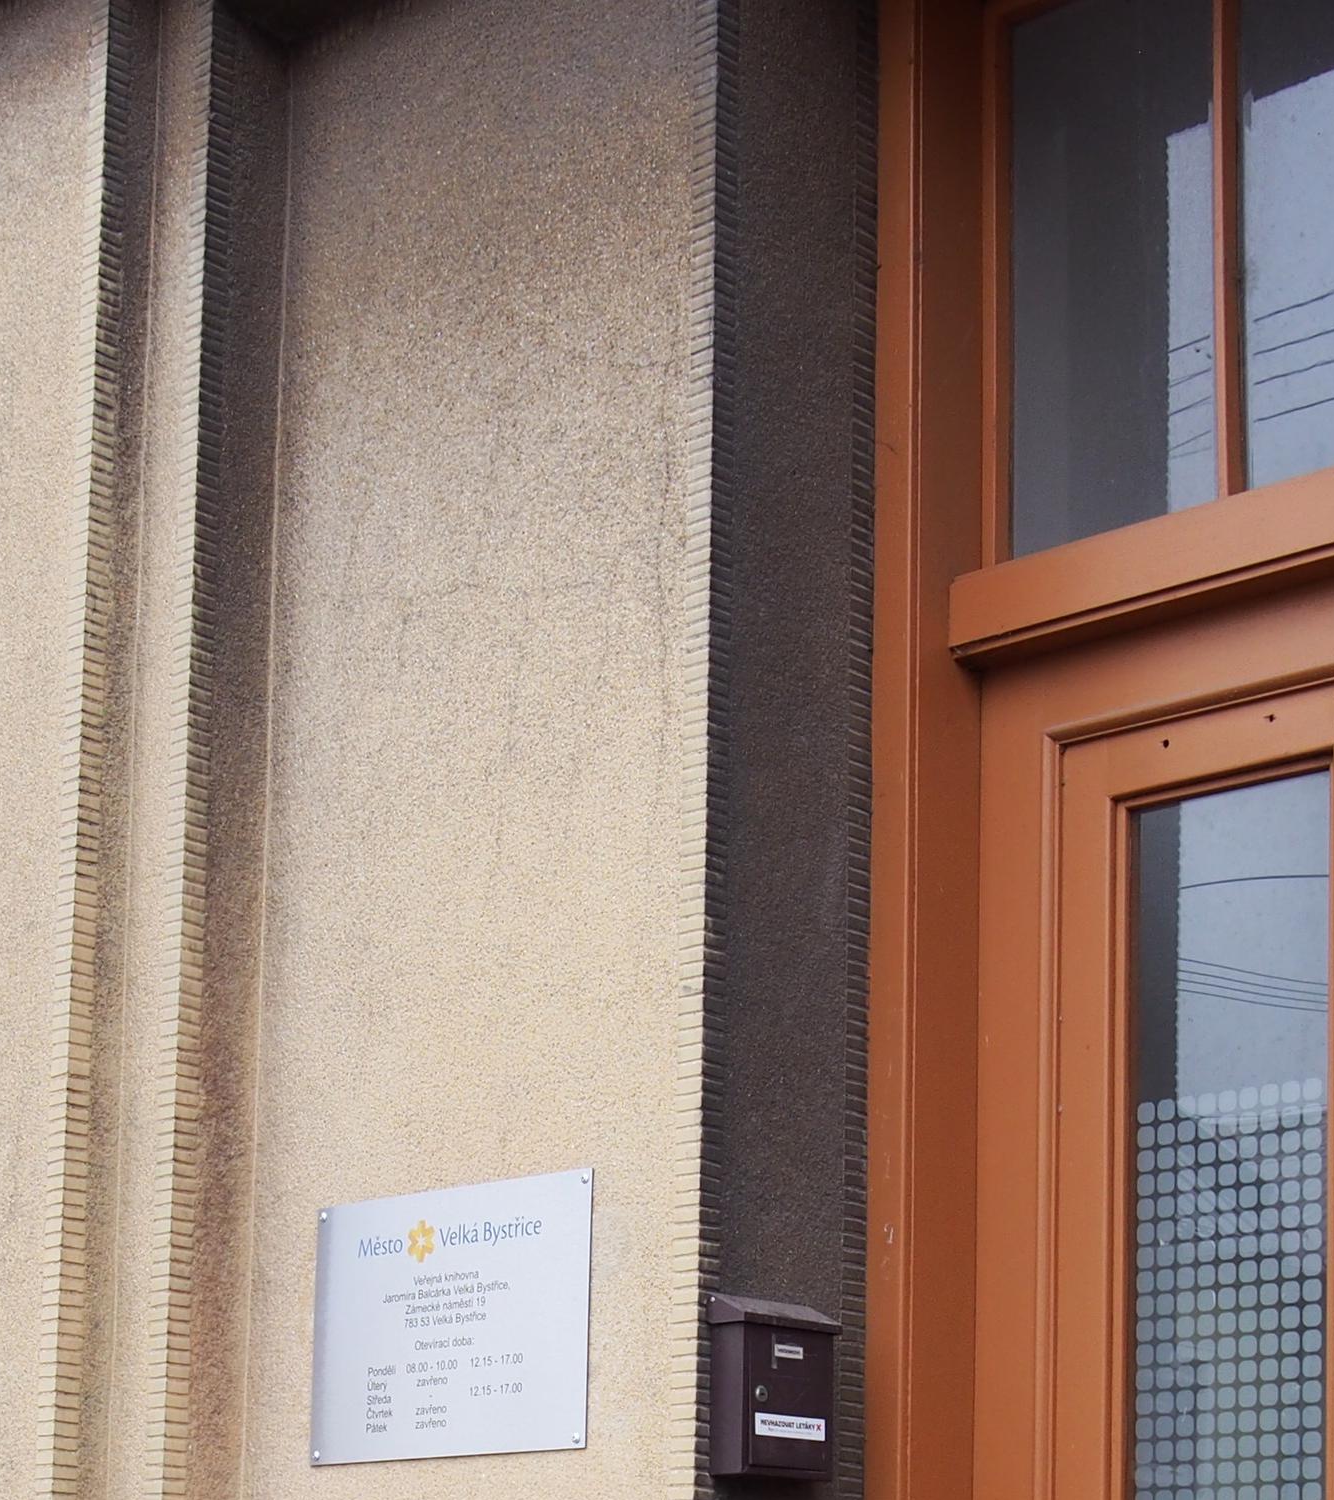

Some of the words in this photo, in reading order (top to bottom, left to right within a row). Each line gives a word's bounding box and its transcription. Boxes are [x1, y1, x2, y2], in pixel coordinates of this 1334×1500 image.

[357, 1236, 403, 1258] Město
[439, 1222, 478, 1247] Velká
[483, 1215, 543, 1246] Bystřice
[413, 1272, 442, 1287] Veřejná
[444, 1270, 479, 1283] knihovna
[418, 1285, 451, 1300] Balcárka
[453, 1283, 475, 1296] Velká
[405, 1300, 441, 1315] Zámecké
[443, 1297, 473, 1311] náměstí
[476, 1295, 486, 1307] 19
[404, 1317, 418, 1329] 783
[420, 1315, 430, 1327] 53
[432, 1312, 453, 1326] Velká
[455, 1310, 487, 1325] Bystřice
[452, 1335, 475, 1348] doba:
[367, 1365, 396, 1377] Pondělí
[405, 1361, 428, 1374] 08.00
[436, 1359, 458, 1371] 10.00
[470, 1355, 493, 1368] 12.15
[501, 1353, 524, 1365] 17.00
[416, 1375, 448, 1387] zavřeno
[367, 1394, 392, 1406] Středa
[469, 1384, 492, 1397] 12.15
[500, 1382, 523, 1394] 17.00
[415, 1404, 447, 1416] zavřeno
[366, 1421, 387, 1434] Pátek
[415, 1418, 447, 1430] zavřeno
[760, 1419, 795, 1429] NEVHAZOVAT
[796, 1420, 815, 1431] LETÁKY
